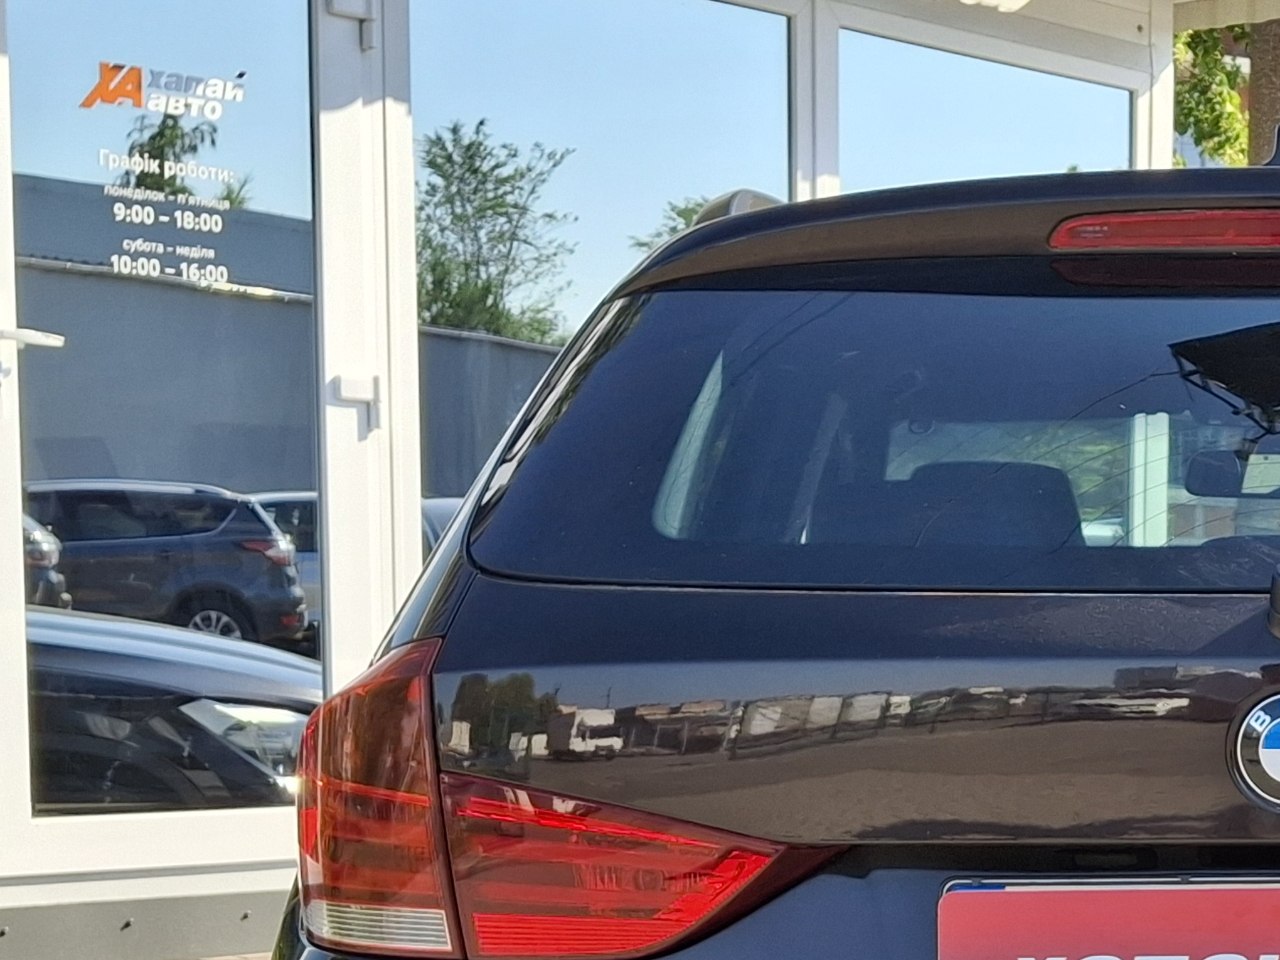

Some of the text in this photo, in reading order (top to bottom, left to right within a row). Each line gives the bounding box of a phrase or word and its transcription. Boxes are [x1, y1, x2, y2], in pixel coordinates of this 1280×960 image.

[147, 69, 247, 102] хапай
[147, 93, 223, 121] авто
[99, 148, 234, 183] Графік роботи:
[104, 185, 166, 202] понеділок
[113, 202, 155, 225] 9:00
[174, 209, 223, 233] 18:00
[122, 238, 164, 254] субота
[176, 245, 215, 259] неділя
[110, 254, 161, 277] 10:00
[180, 261, 228, 283] 16:00
